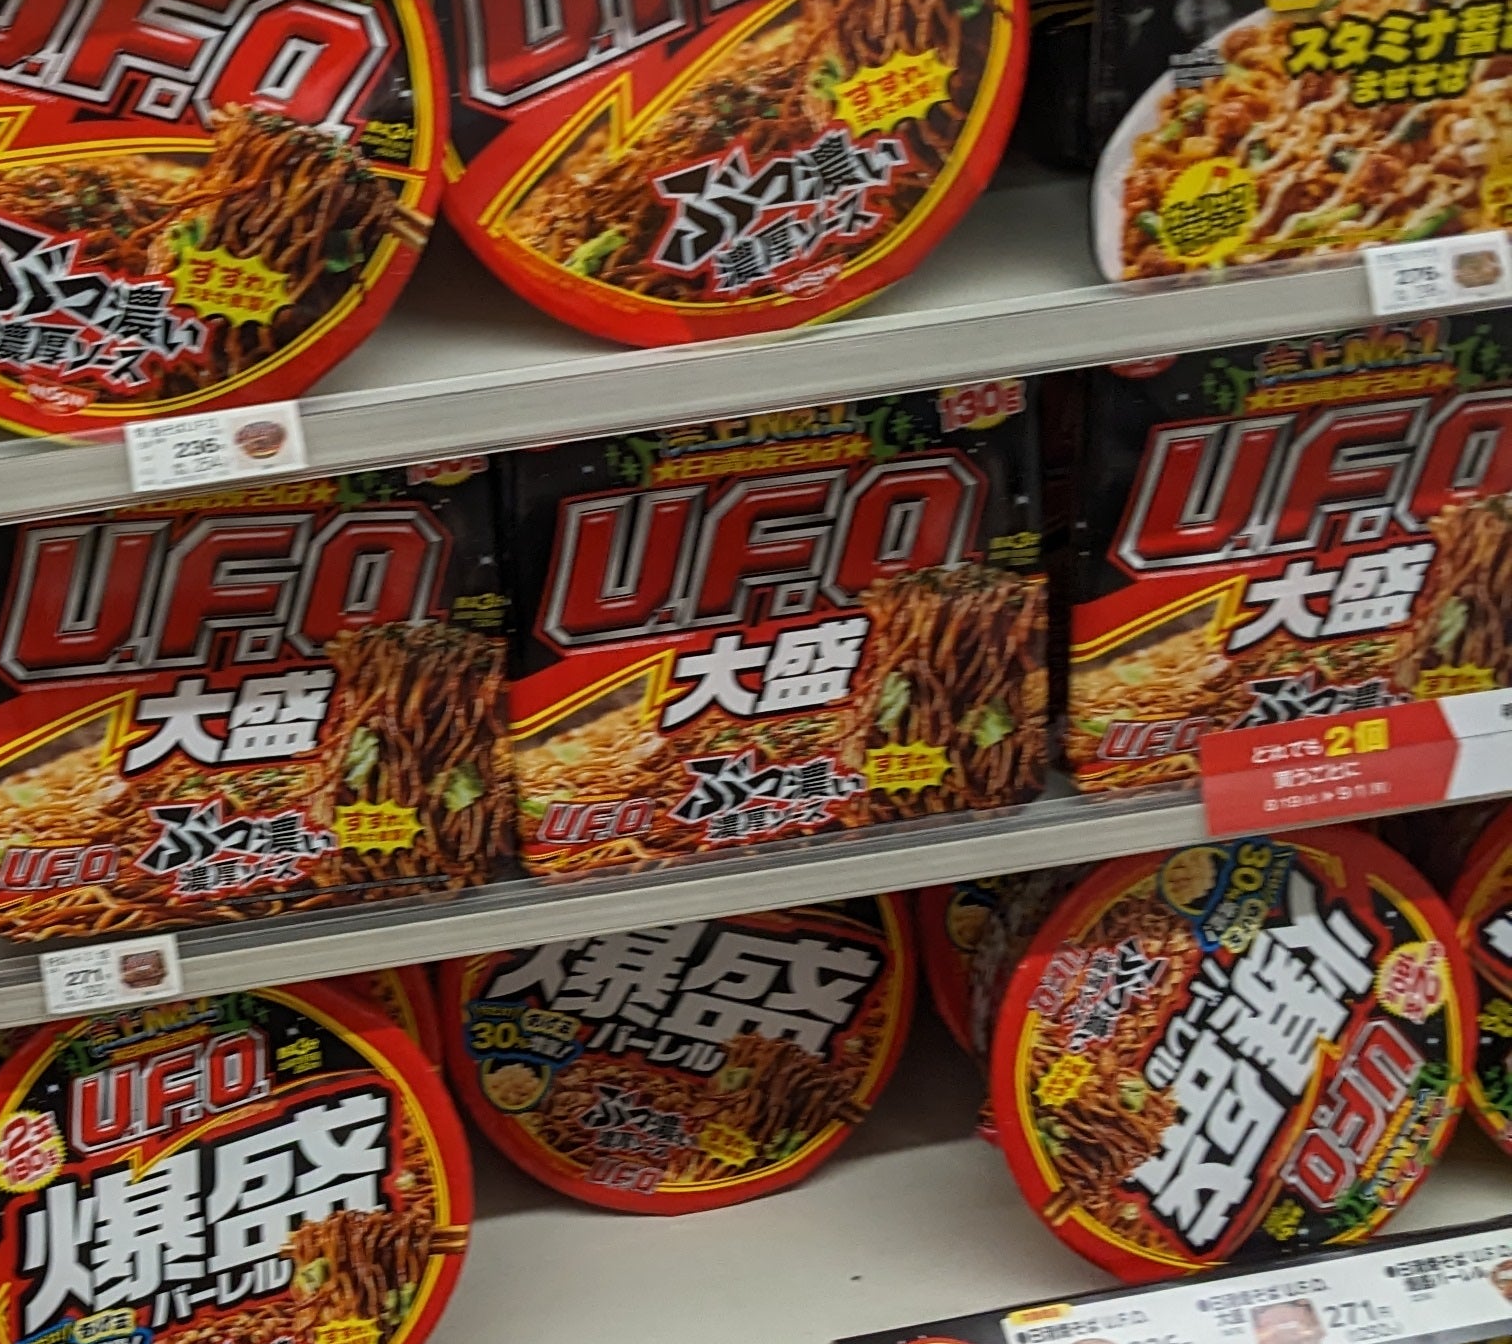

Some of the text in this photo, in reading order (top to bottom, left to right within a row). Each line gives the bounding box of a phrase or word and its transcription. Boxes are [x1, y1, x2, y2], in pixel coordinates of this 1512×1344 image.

[1351, 60, 1473, 106] まぜそば
[652, 128, 910, 272] ぶっ濃い
[172, 437, 222, 460] 236
[1228, 542, 1436, 653] 大盛
[125, 669, 337, 775] 大盛
[661, 616, 872, 730] 大盛
[136, 800, 336, 876] ぶっ濃い
[670, 752, 867, 826] ぶっ濃い
[63, 967, 107, 989] 271
[486, 920, 883, 1055] 爆盛
[1143, 957, 1235, 1091] バーレル
[590, 1024, 727, 1076] バーレル
[1128, 868, 1378, 1248] 爆盛
[23, 1092, 388, 1331] 爆盛
[152, 1257, 293, 1328] バーレル
